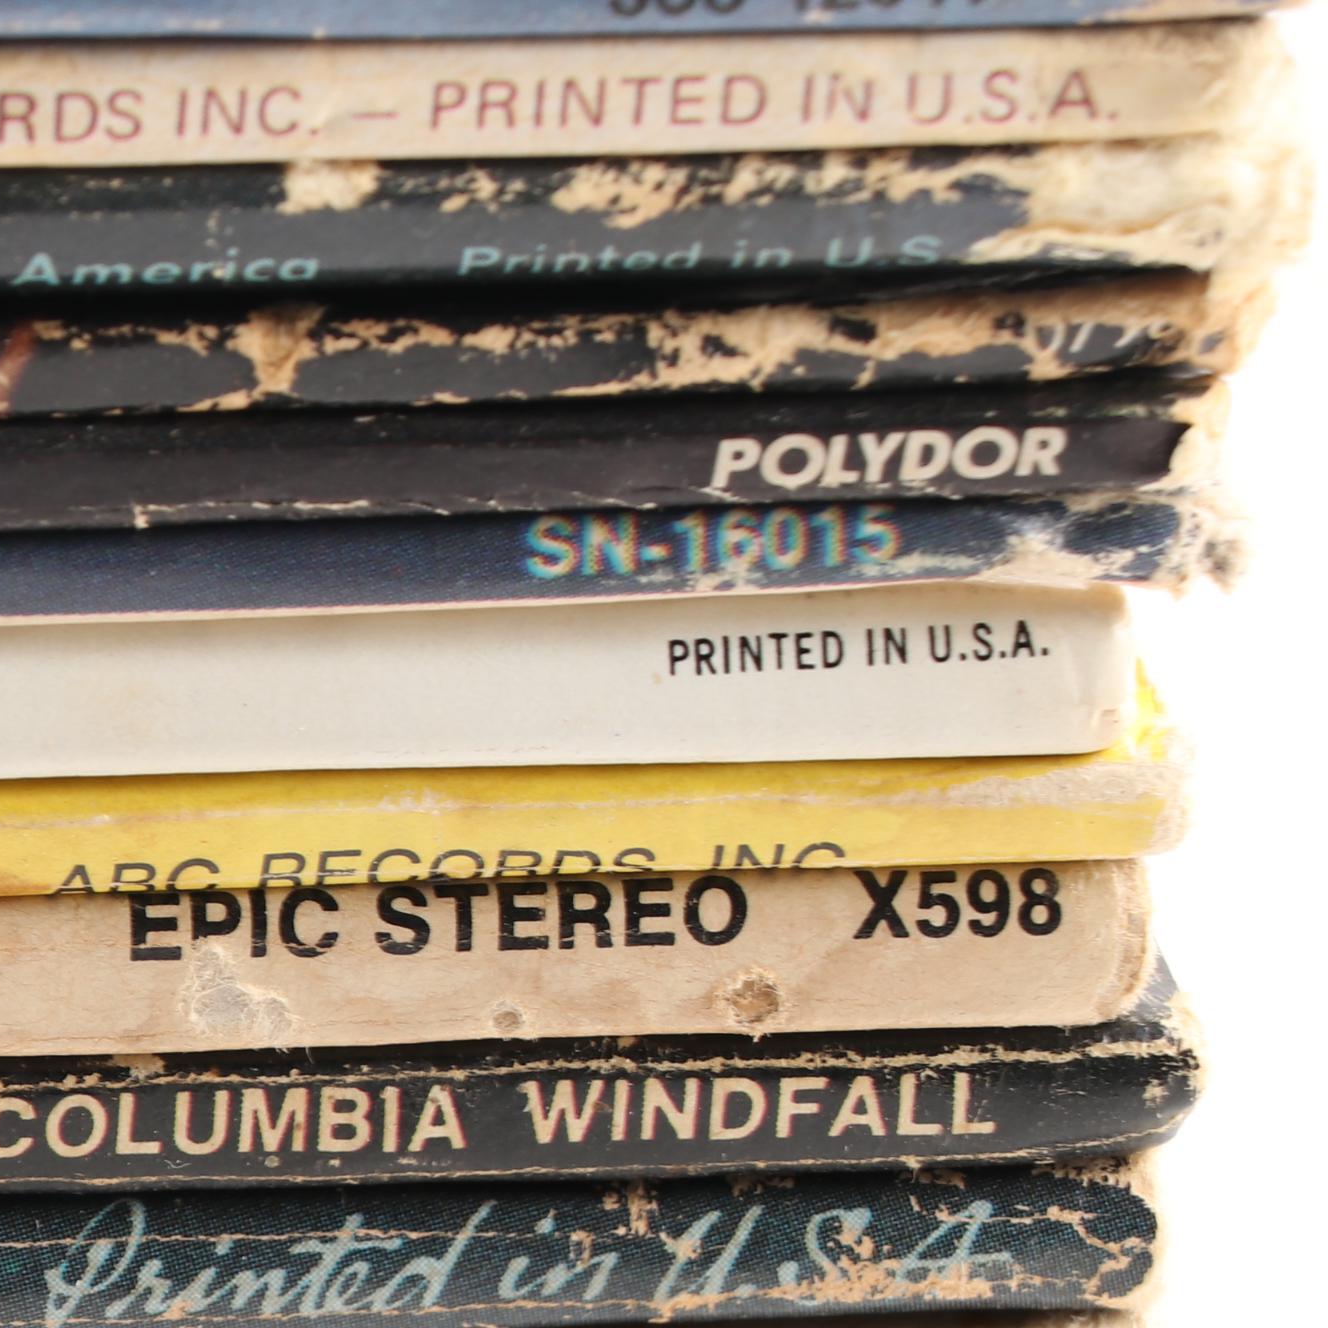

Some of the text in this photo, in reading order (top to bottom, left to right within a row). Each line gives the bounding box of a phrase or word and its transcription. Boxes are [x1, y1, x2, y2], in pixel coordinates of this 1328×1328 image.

[174, 84, 321, 140] INC.
[431, 73, 768, 132] PRINTED
[801, 72, 868, 127] IN
[905, 67, 1121, 126] U.S.A.
[11, 250, 322, 290] America
[458, 240, 703, 277] Printed
[730, 239, 794, 270] in
[710, 425, 1070, 490] POLYDOR
[524, 504, 904, 580] SN-16015
[667, 619, 1051, 676] PRINTED IN U.S.A.
[128, 867, 1064, 962] EPIC STEREO X598
[522, 1070, 997, 1146] WINDFALL
[497, 1208, 620, 1301] in
